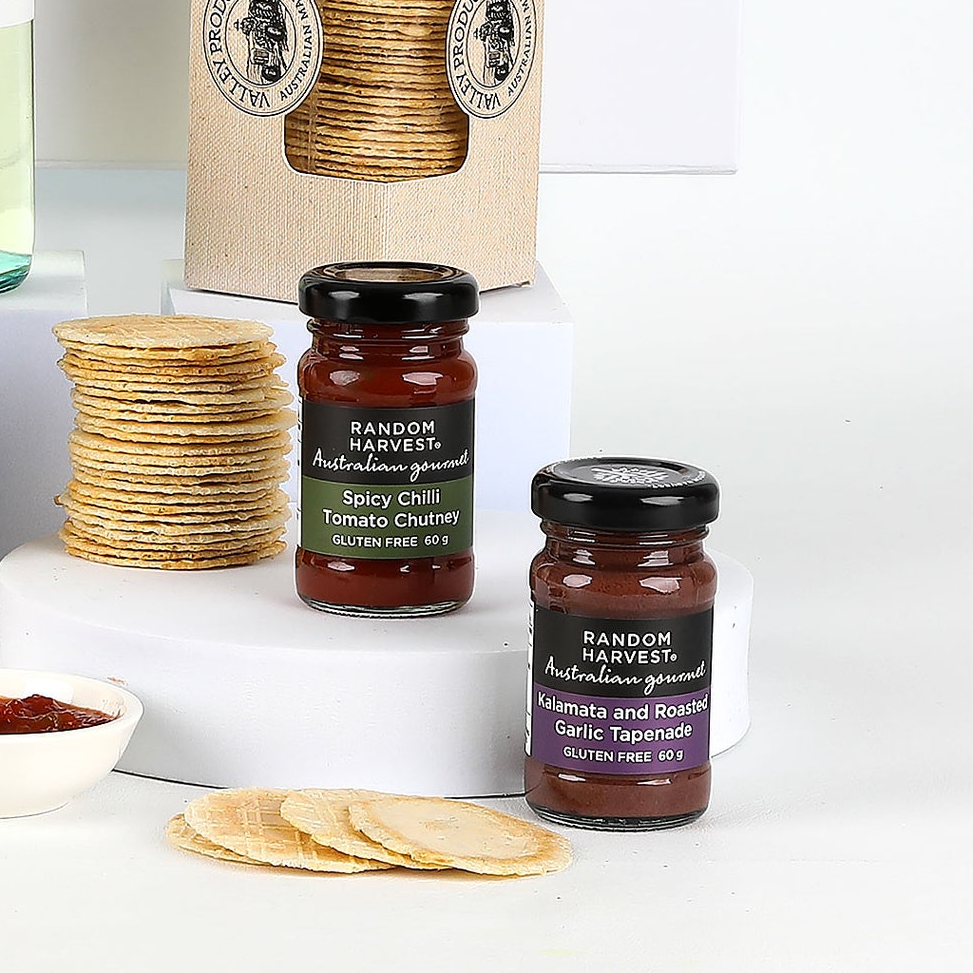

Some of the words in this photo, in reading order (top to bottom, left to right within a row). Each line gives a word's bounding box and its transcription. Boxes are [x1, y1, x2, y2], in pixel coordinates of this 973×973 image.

[279, 25, 314, 102] AUSTRALIAN
[506, 15, 533, 97] AUSTRALIAN
[212, 58, 272, 109] VALLEY
[456, 70, 502, 111] VALLEY
[350, 420, 435, 436] RANDOM
[312, 447, 408, 473] Australian
[409, 448, 470, 483] gourmet
[342, 490, 392, 509] Spicy
[397, 488, 440, 506] Chilli
[323, 508, 389, 528] Tomato
[394, 509, 460, 528] Chutney
[332, 534, 382, 548] GLUTEN
[385, 536, 418, 548] FREE
[583, 630, 672, 647] RANDOM
[545, 655, 642, 685] Australian
[643, 660, 707, 696] gourmet
[537, 691, 607, 719] Kalamata
[613, 704, 649, 720] and
[655, 693, 709, 719] Roasted
[555, 720, 604, 741] Garlic
[609, 722, 693, 744] Tapenade
[563, 746, 614, 762] GLUTEN
[617, 751, 652, 763] FREE
